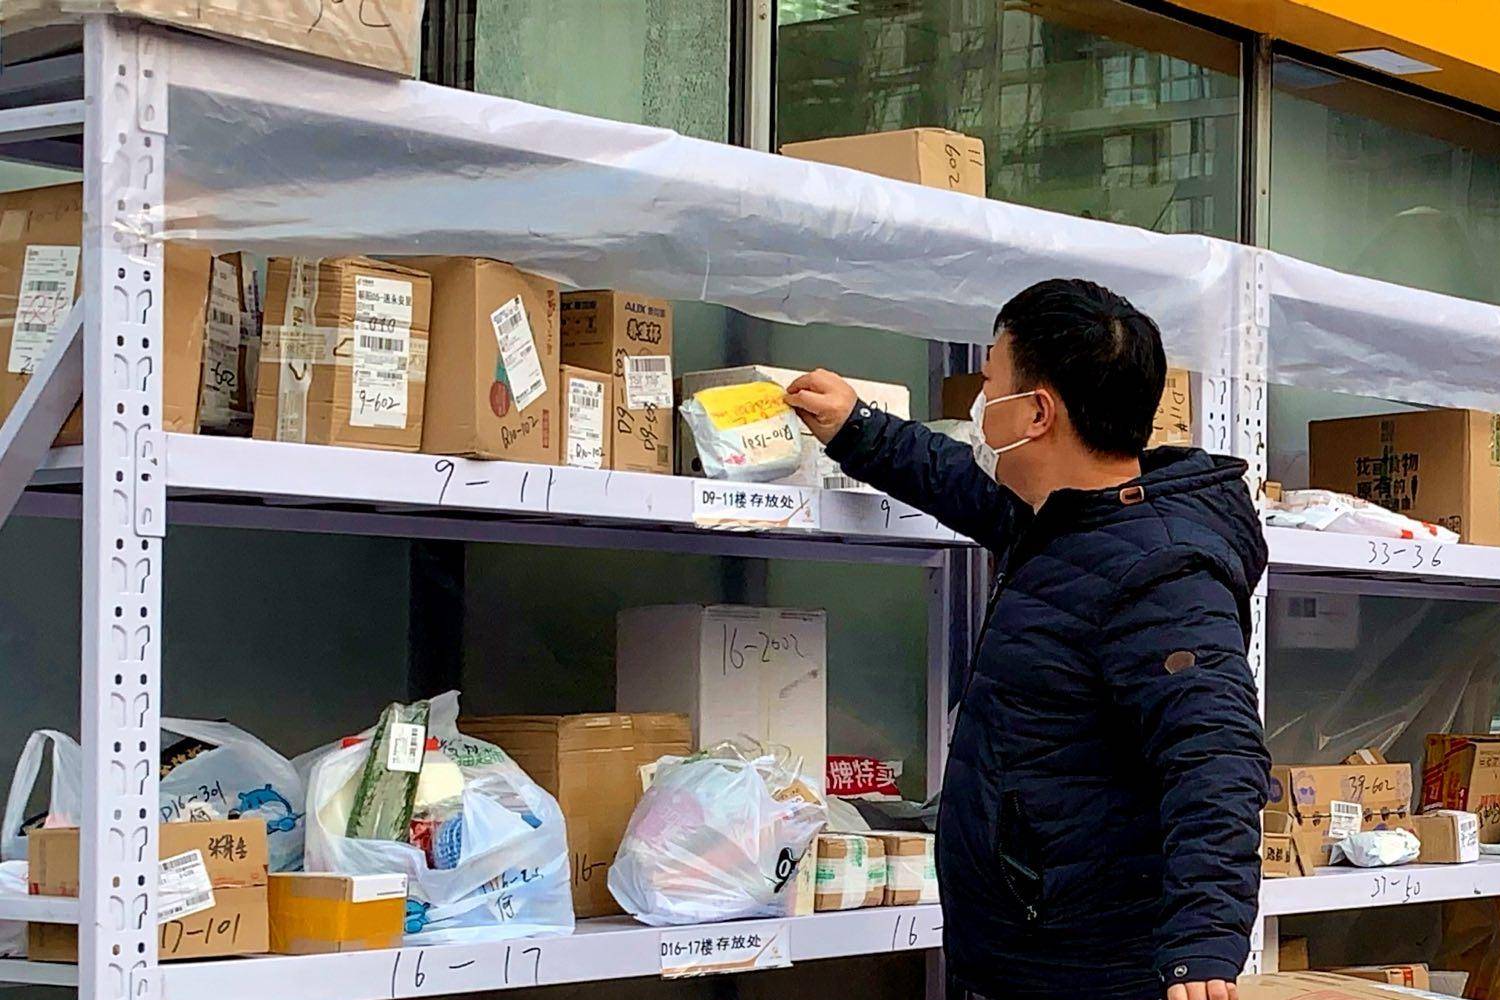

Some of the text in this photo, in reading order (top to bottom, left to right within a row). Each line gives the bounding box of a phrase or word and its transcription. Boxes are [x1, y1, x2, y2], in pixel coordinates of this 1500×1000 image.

[359, 389, 401, 414] 9-602
[702, 490, 795, 510] D9-11楼 存放处
[1367, 539, 1443, 570] 33-36
[660, 934, 762, 957] D16-17楼 存放处
